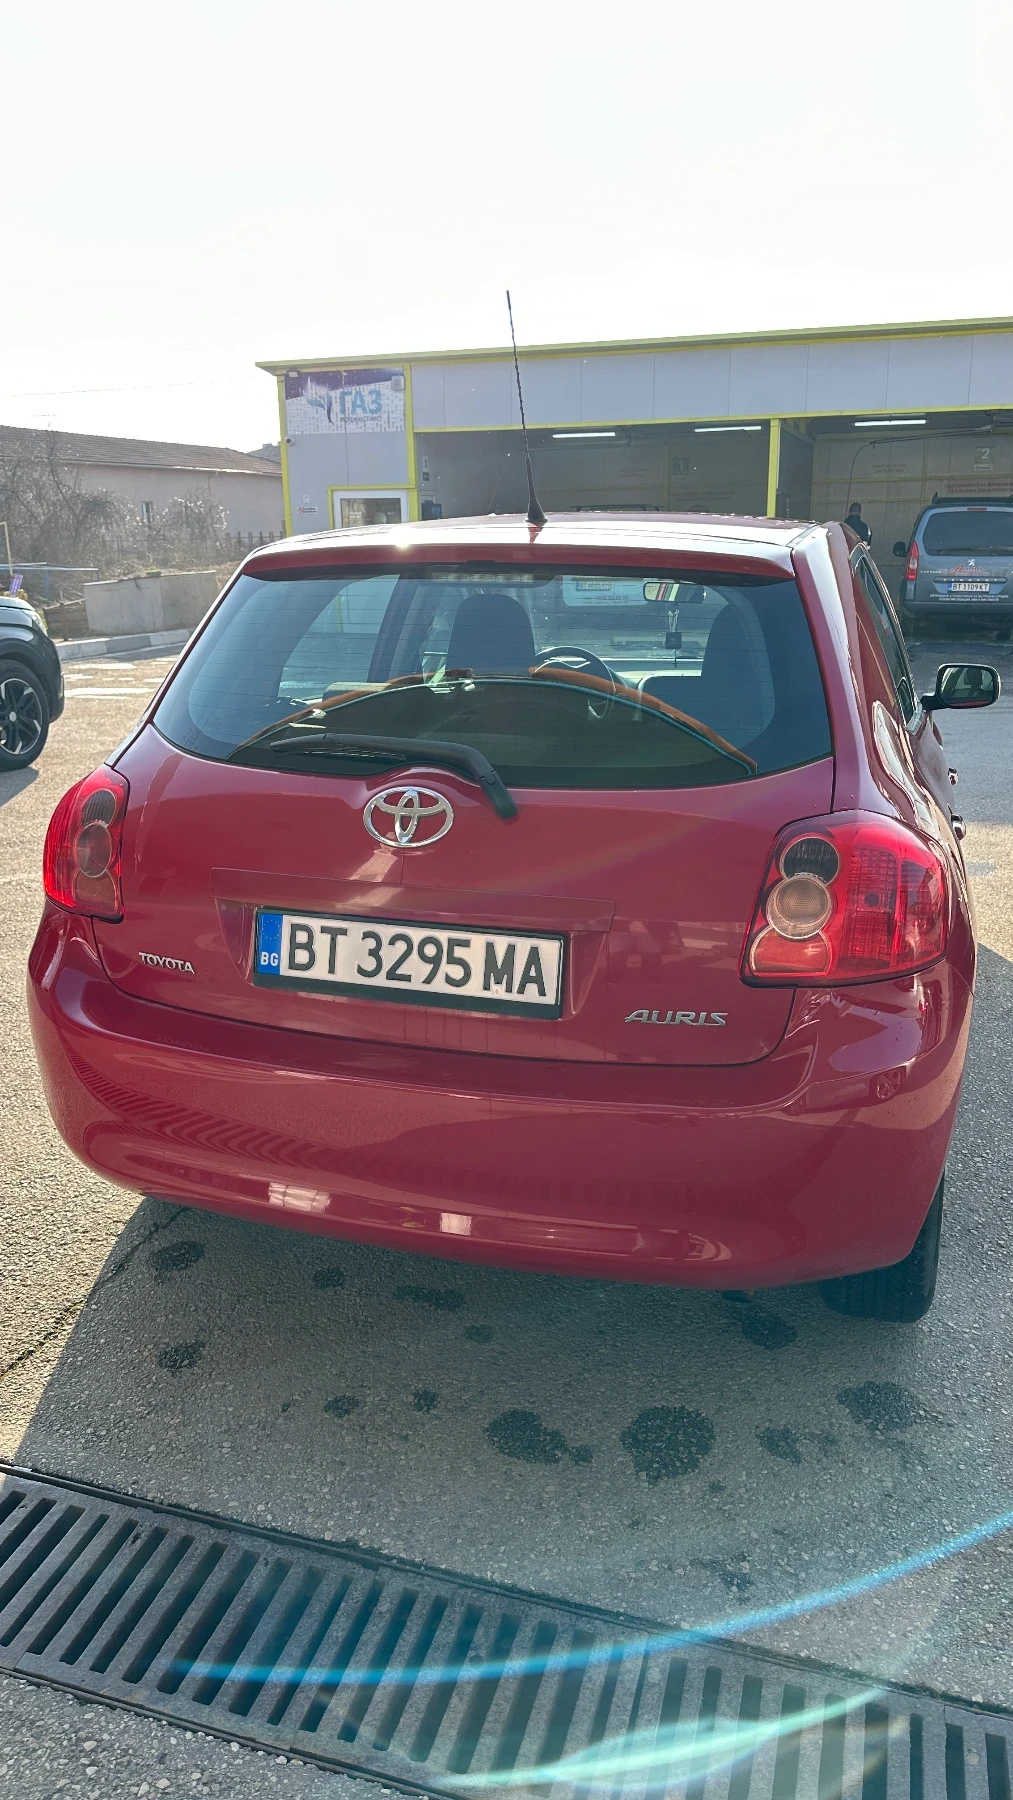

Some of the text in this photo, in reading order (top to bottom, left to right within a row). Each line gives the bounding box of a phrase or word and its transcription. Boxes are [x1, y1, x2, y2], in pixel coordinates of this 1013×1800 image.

[339, 390, 383, 415] ГАЗ
[980, 447, 991, 460] 2
[138, 951, 195, 975] TOYOTA
[260, 951, 279, 967] BG
[288, 923, 547, 998] BT 3295 MA
[624, 1009, 728, 1027] AURIS
